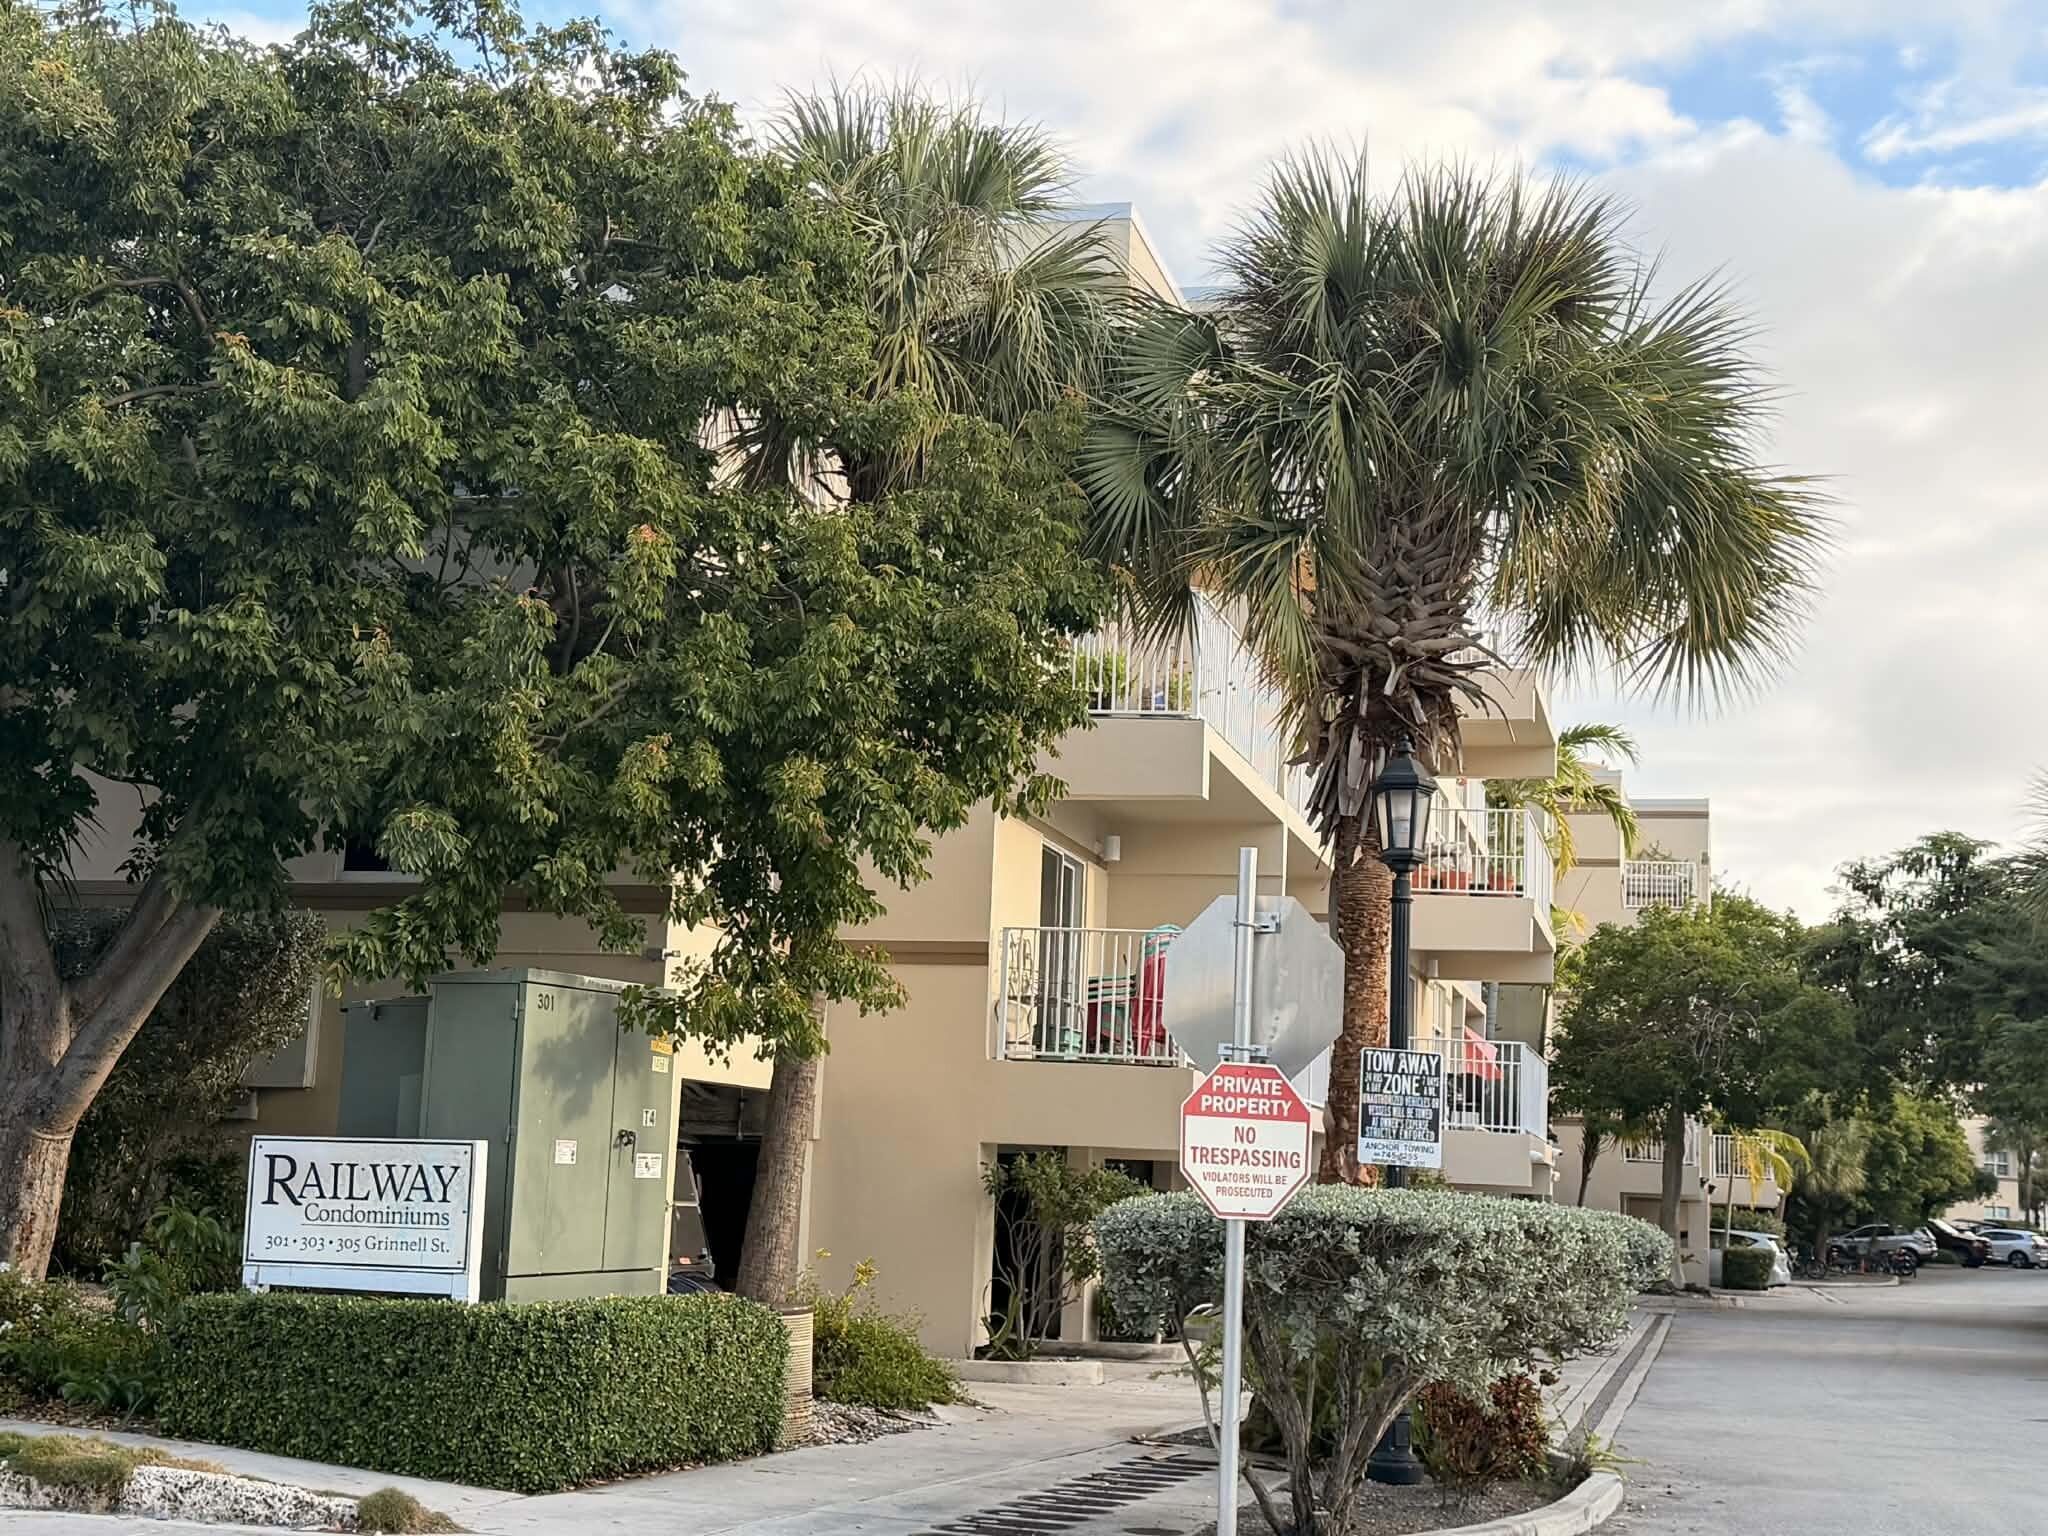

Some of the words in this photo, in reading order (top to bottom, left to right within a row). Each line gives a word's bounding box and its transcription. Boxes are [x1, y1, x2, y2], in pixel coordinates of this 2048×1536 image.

[537, 993, 554, 1012] 301
[1365, 1050, 1395, 1072] TOW
[1398, 1053, 1439, 1076] AWAY
[1212, 1075, 1283, 1096] PRIVATE
[1383, 1074, 1420, 1096] ZONE
[1201, 1094, 1292, 1117] PROPERTY
[1405, 1096, 1430, 1108] VEHICLES
[1392, 1106, 1404, 1118] WILL
[1406, 1107, 1414, 1118] BE
[1415, 1108, 1433, 1120] TOWED
[1234, 1126, 1256, 1144] NO
[1365, 1126, 1397, 1139] STRICTLY
[1399, 1128, 1435, 1142] ENFORCED
[1191, 1146, 1301, 1168] TRESPASSING
[1365, 1142, 1400, 1152] ANCHOR
[1403, 1143, 1435, 1154] TOWING
[261, 1154, 461, 1206] RAILWAY
[1202, 1171, 1251, 1184] VIOLATORS
[1252, 1174, 1273, 1185] WILL
[1275, 1175, 1288, 1185] BE
[1216, 1186, 1273, 1198] PROSECUTED
[304, 1203, 450, 1226] Condominiums
[265, 1235, 289, 1250] 301
[301, 1237, 325, 1252] 303
[335, 1238, 361, 1254] 305
[364, 1235, 427, 1252] Grinnell
[431, 1238, 450, 1253] St.
